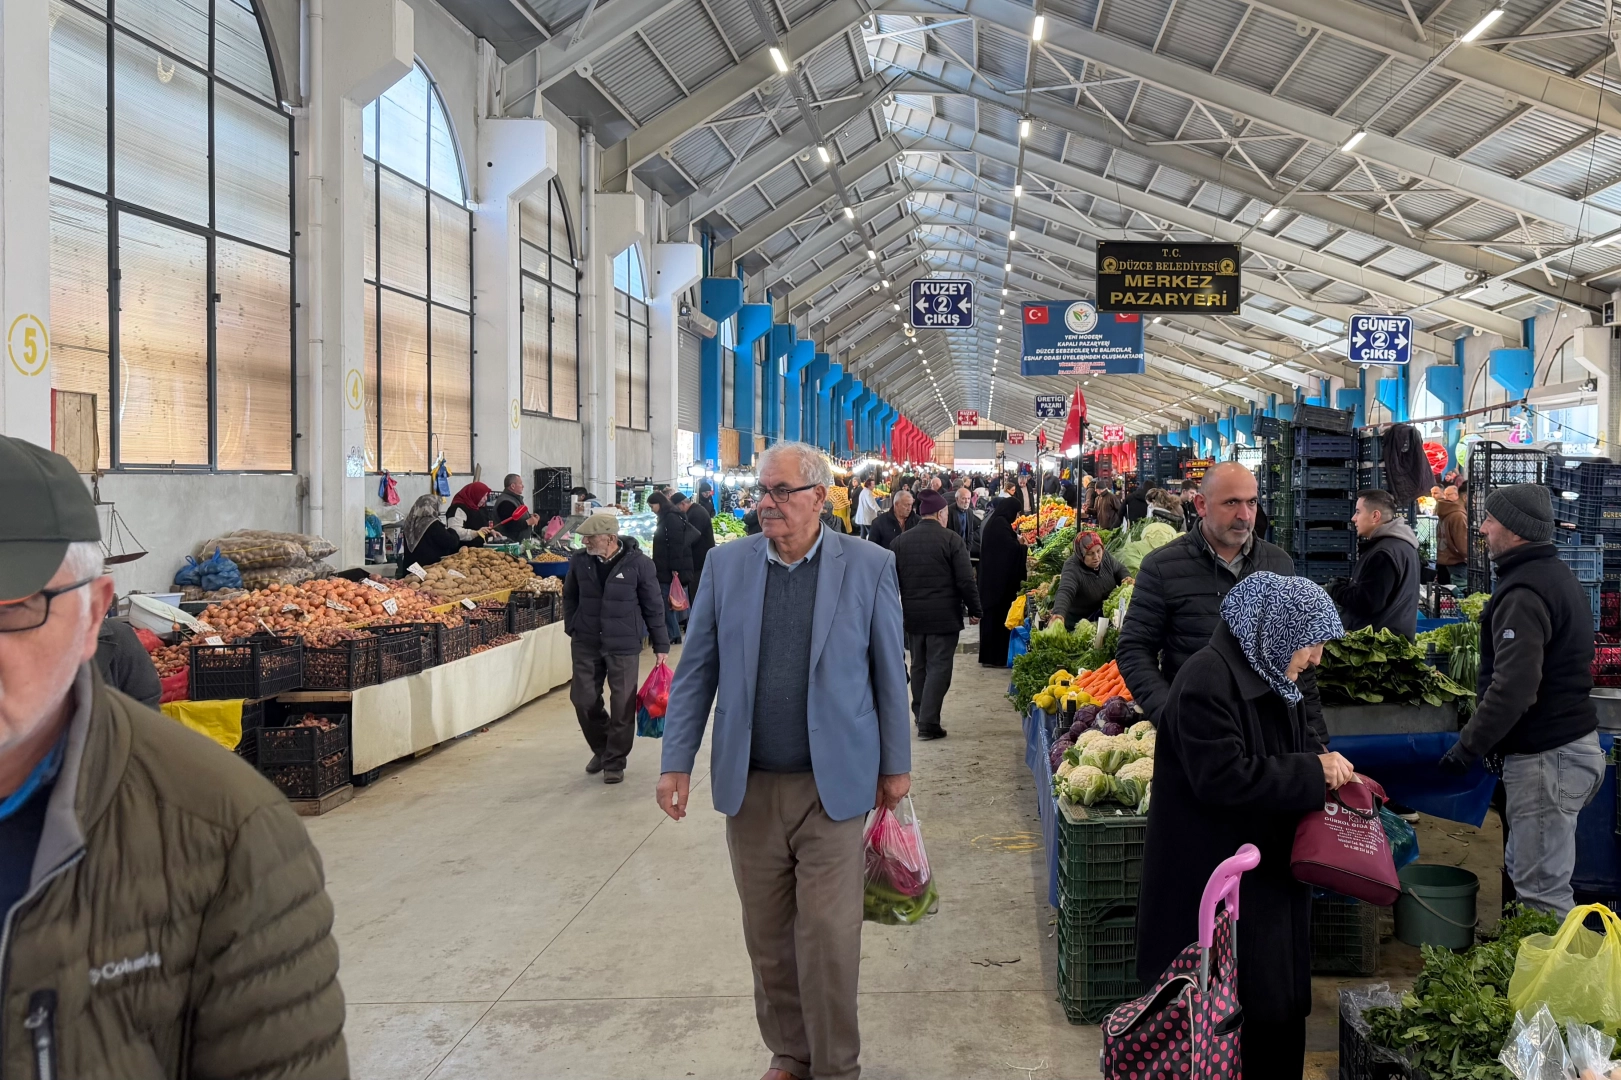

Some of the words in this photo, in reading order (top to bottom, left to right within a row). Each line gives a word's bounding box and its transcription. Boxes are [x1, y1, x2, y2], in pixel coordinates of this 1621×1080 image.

[1119, 259, 1153, 271] DÜZCE
[1156, 260, 1218, 272] BELEDİYESİ
[1124, 274, 1212, 288] MERKEZ
[920, 283, 967, 295] KUZEY
[937, 297, 948, 312] 2
[1110, 290, 1227, 306] PAZARYERİ
[924, 314, 960, 326] ÇIKIŞ
[1358, 317, 1407, 332] GÜNEY
[23, 326, 37, 364] 5
[1374, 332, 1386, 347] 2
[1360, 348, 1397, 362] ÇIKIŞ
[352, 377, 359, 402] 4
[1047, 409, 1054, 417] 2
